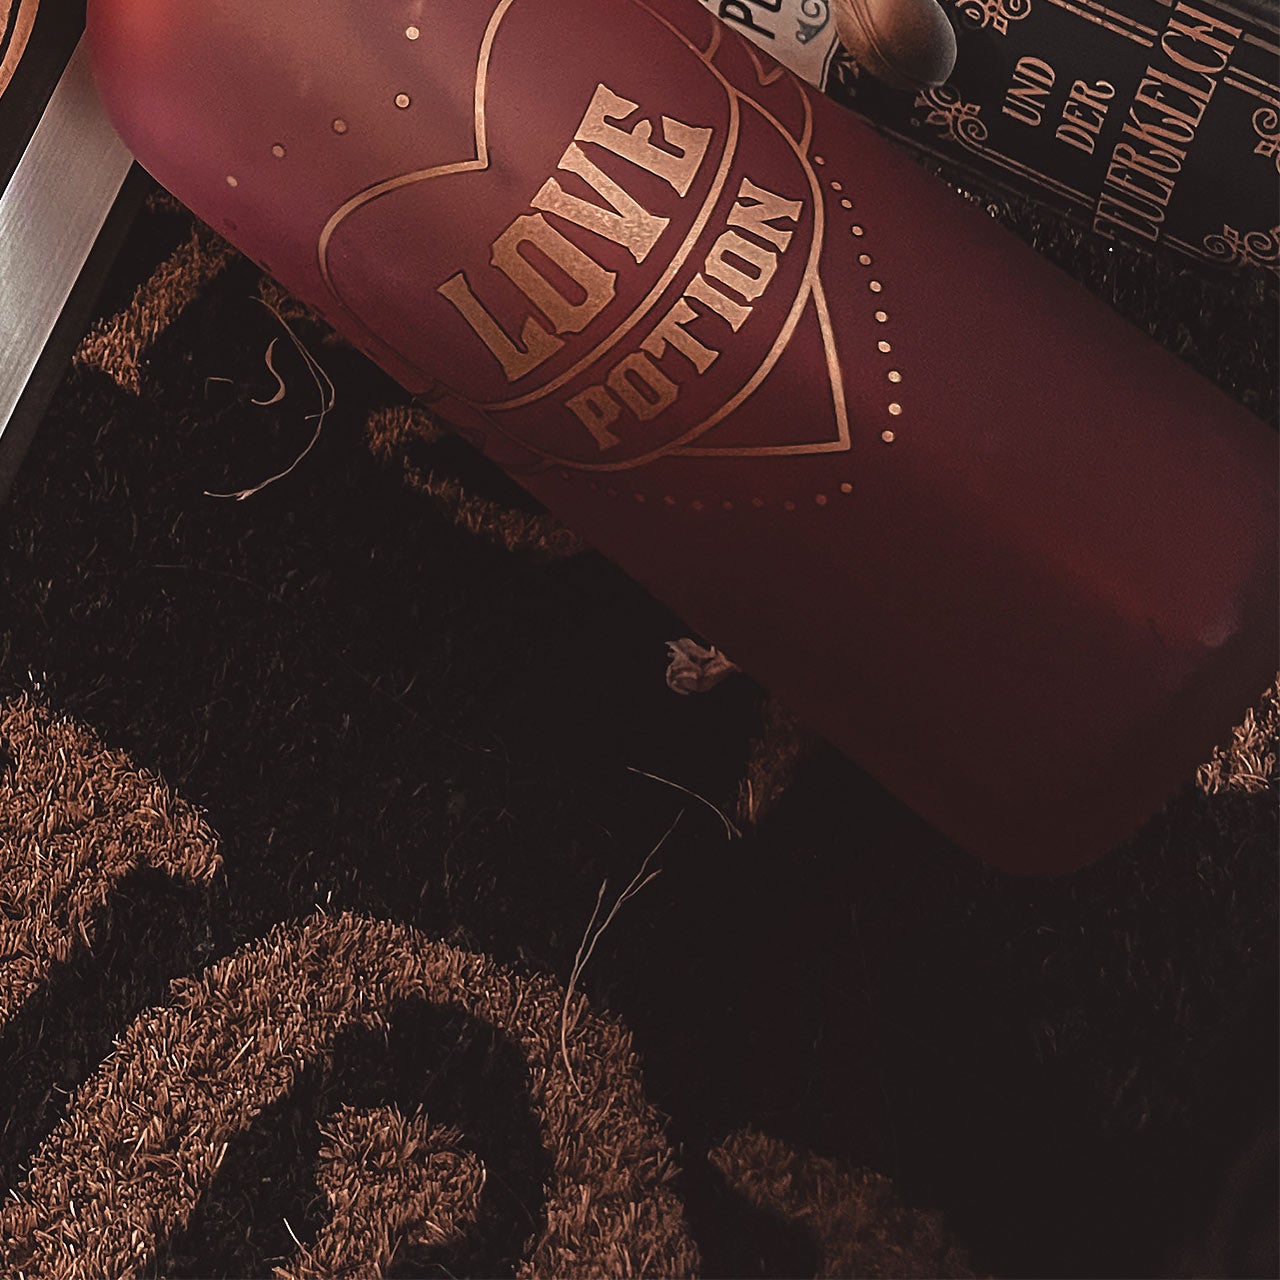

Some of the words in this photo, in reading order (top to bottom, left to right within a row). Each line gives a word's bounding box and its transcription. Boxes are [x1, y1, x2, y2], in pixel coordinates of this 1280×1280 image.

[1001, 56, 1056, 127] UND
[1055, 79, 1117, 155] DER
[437, 82, 714, 383] LOVE
[565, 177, 804, 452] POTION
